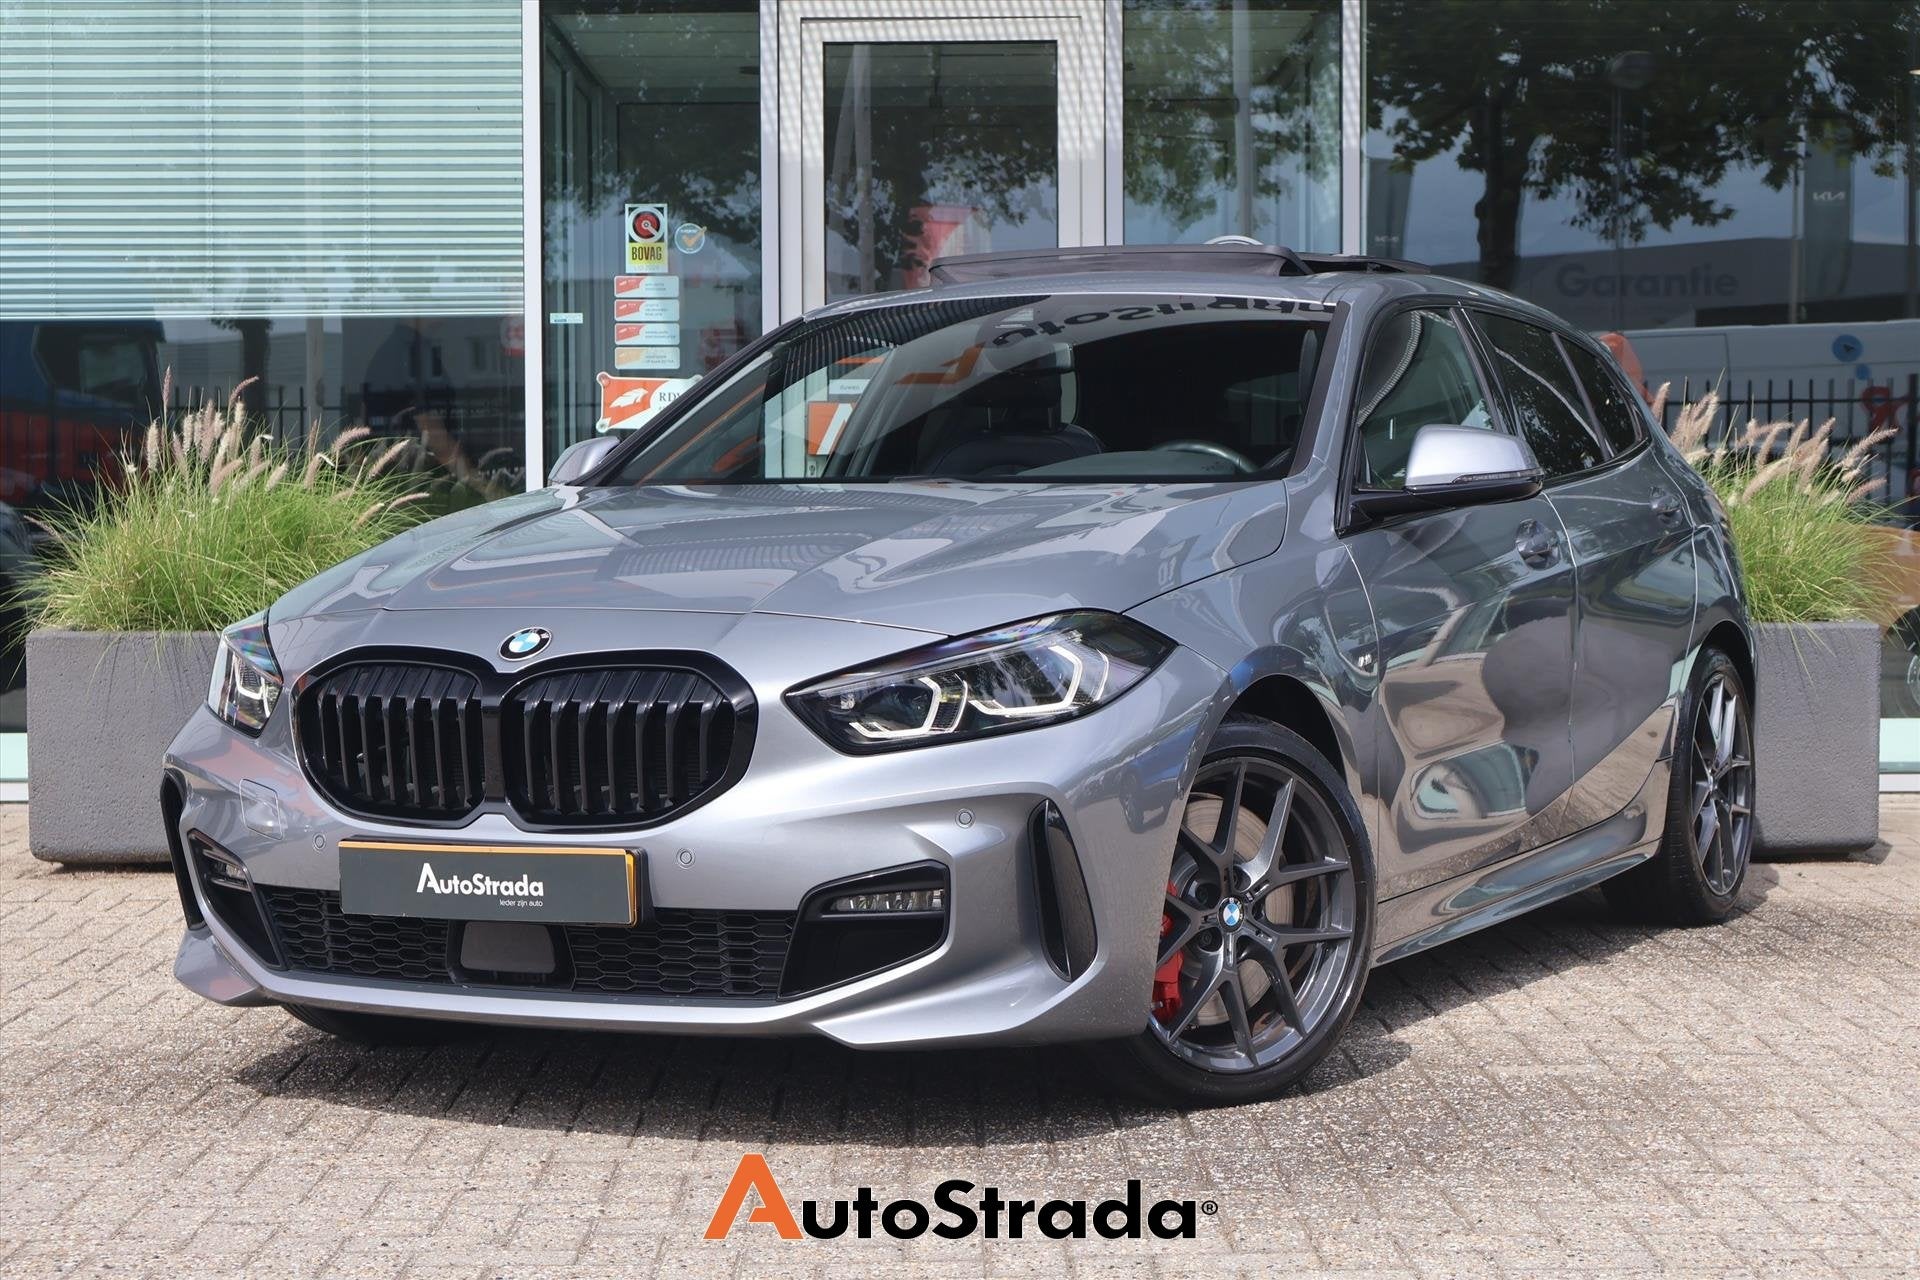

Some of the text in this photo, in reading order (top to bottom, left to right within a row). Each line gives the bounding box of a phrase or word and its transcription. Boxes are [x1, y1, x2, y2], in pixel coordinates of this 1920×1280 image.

[631, 246, 663, 261] BOVAG
[1555, 262, 1739, 297] Garantie
[416, 862, 544, 897] AutoStrada
[517, 899, 528, 908] zijn
[528, 899, 544, 907] auto
